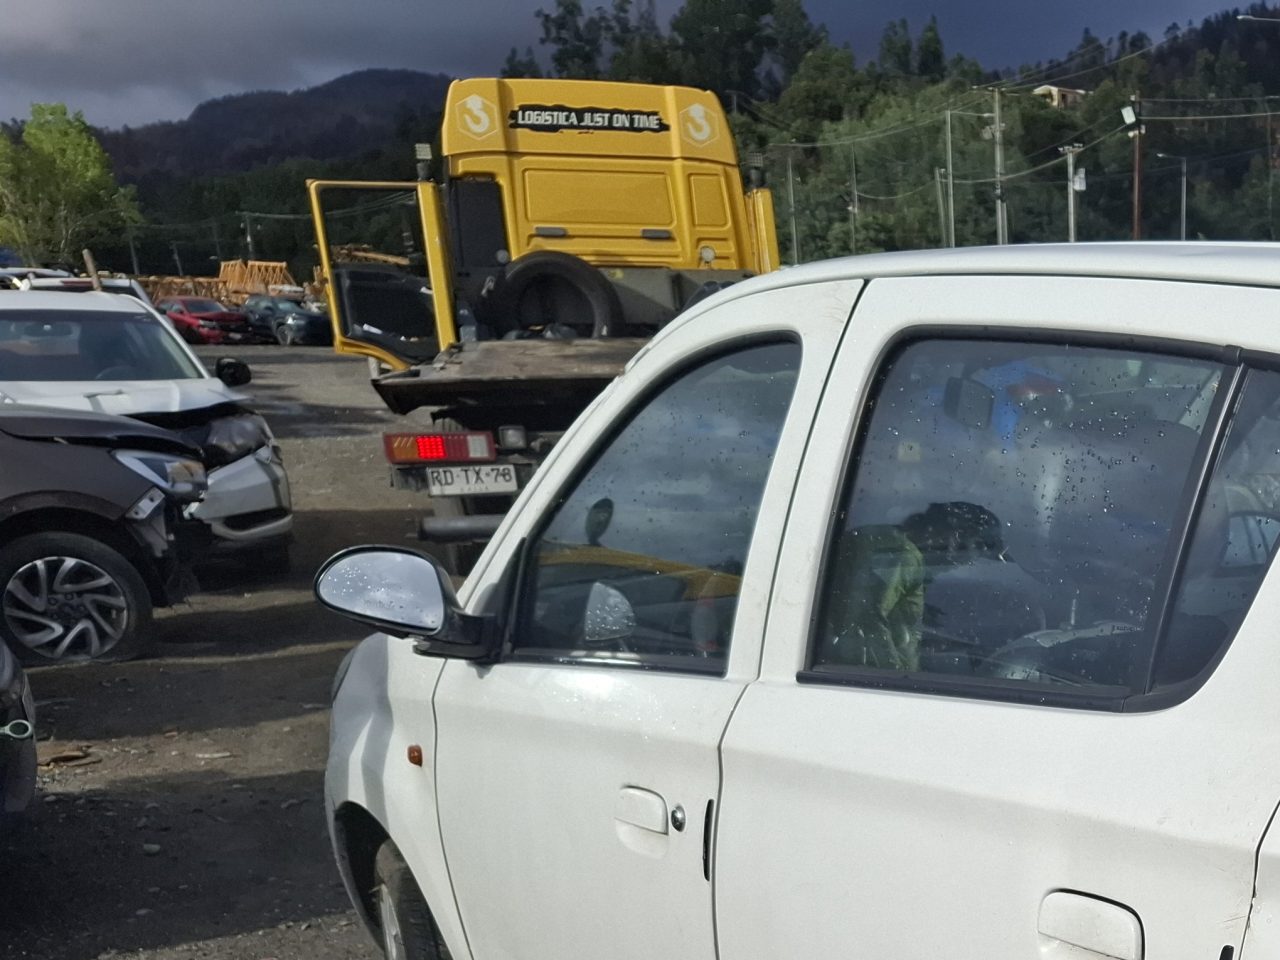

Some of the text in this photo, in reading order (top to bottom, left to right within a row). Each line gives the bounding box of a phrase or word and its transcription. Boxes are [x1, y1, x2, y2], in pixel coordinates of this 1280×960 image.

[517, 110, 660, 129] LOGISTICA JUST ON TIME
